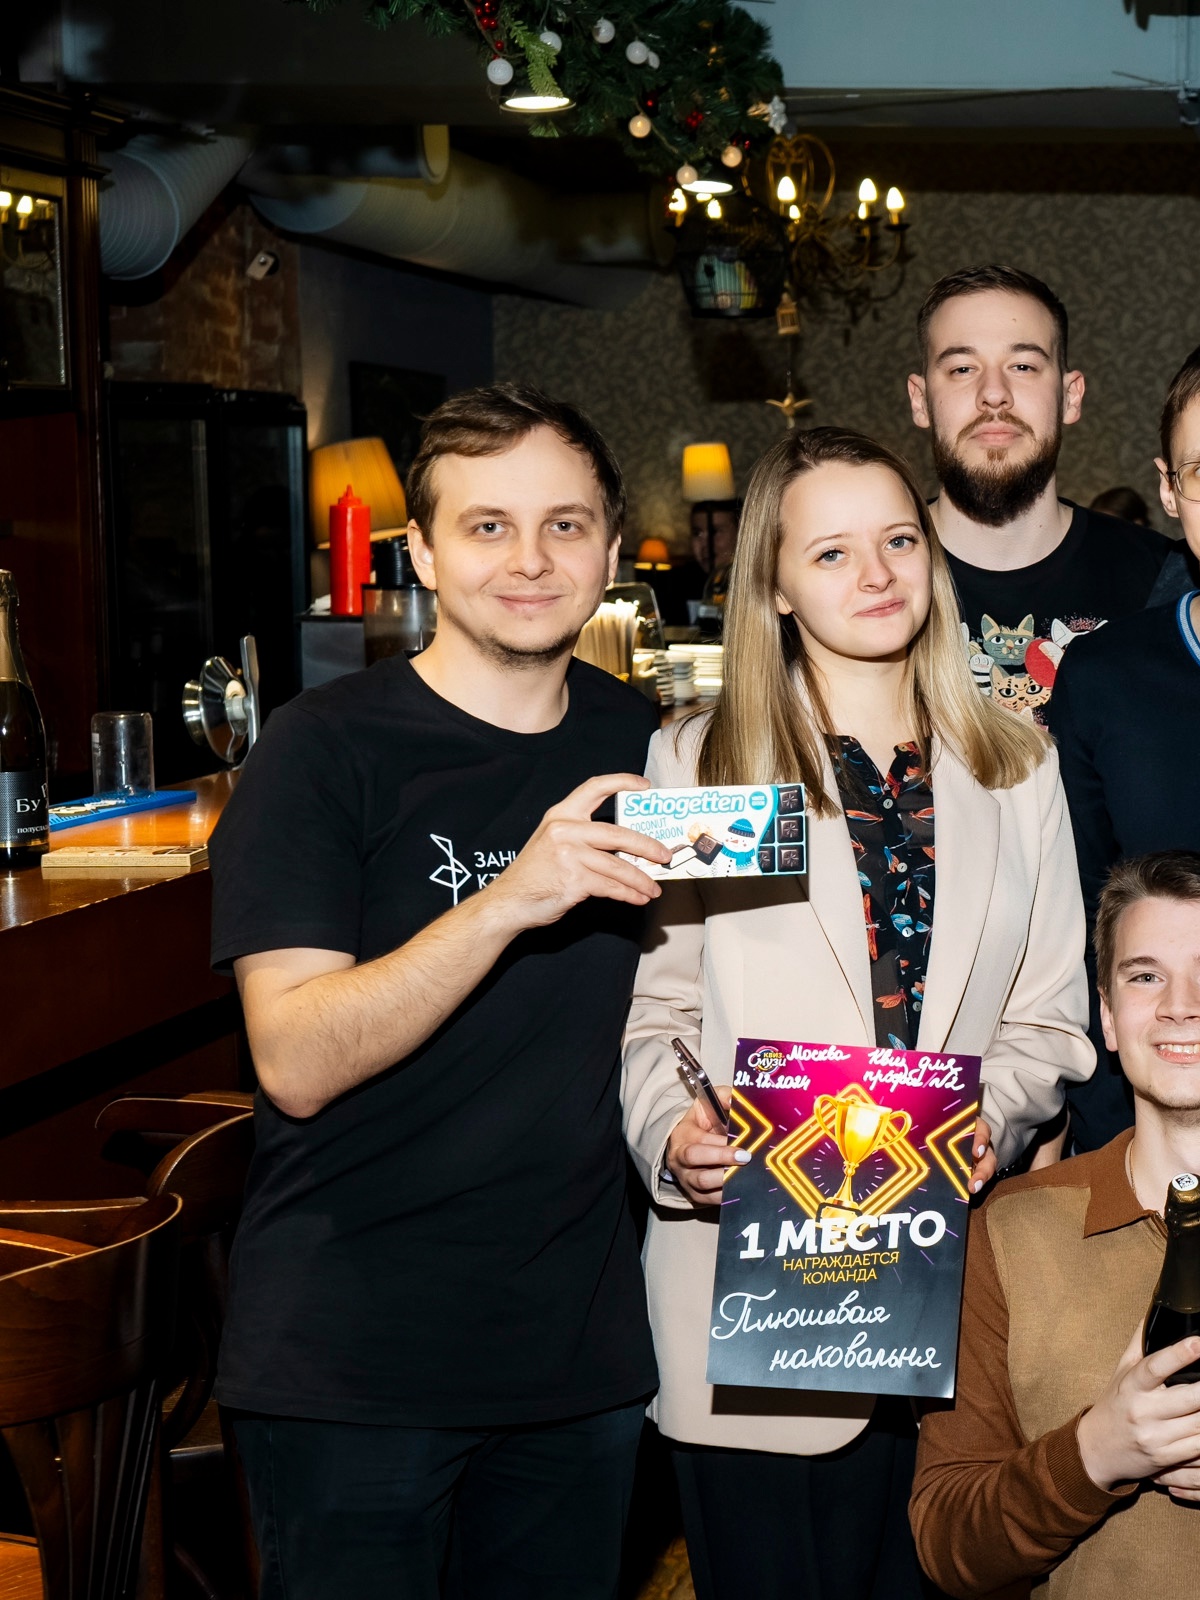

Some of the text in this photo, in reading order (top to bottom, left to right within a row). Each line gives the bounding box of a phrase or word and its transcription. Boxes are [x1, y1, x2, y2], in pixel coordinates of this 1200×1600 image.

[624, 790, 745, 819] Schogetten
[630, 816, 667, 833] COCONUT
[786, 1045, 851, 1062] Москва
[739, 1210, 947, 1260] 1 МЕСТО
[783, 1251, 900, 1272] НАГРАЖДАЕТСЯ
[802, 1267, 878, 1285] КОМАНДА
[711, 1289, 890, 1340] Плюшевая
[769, 1331, 942, 1371] наковальня
